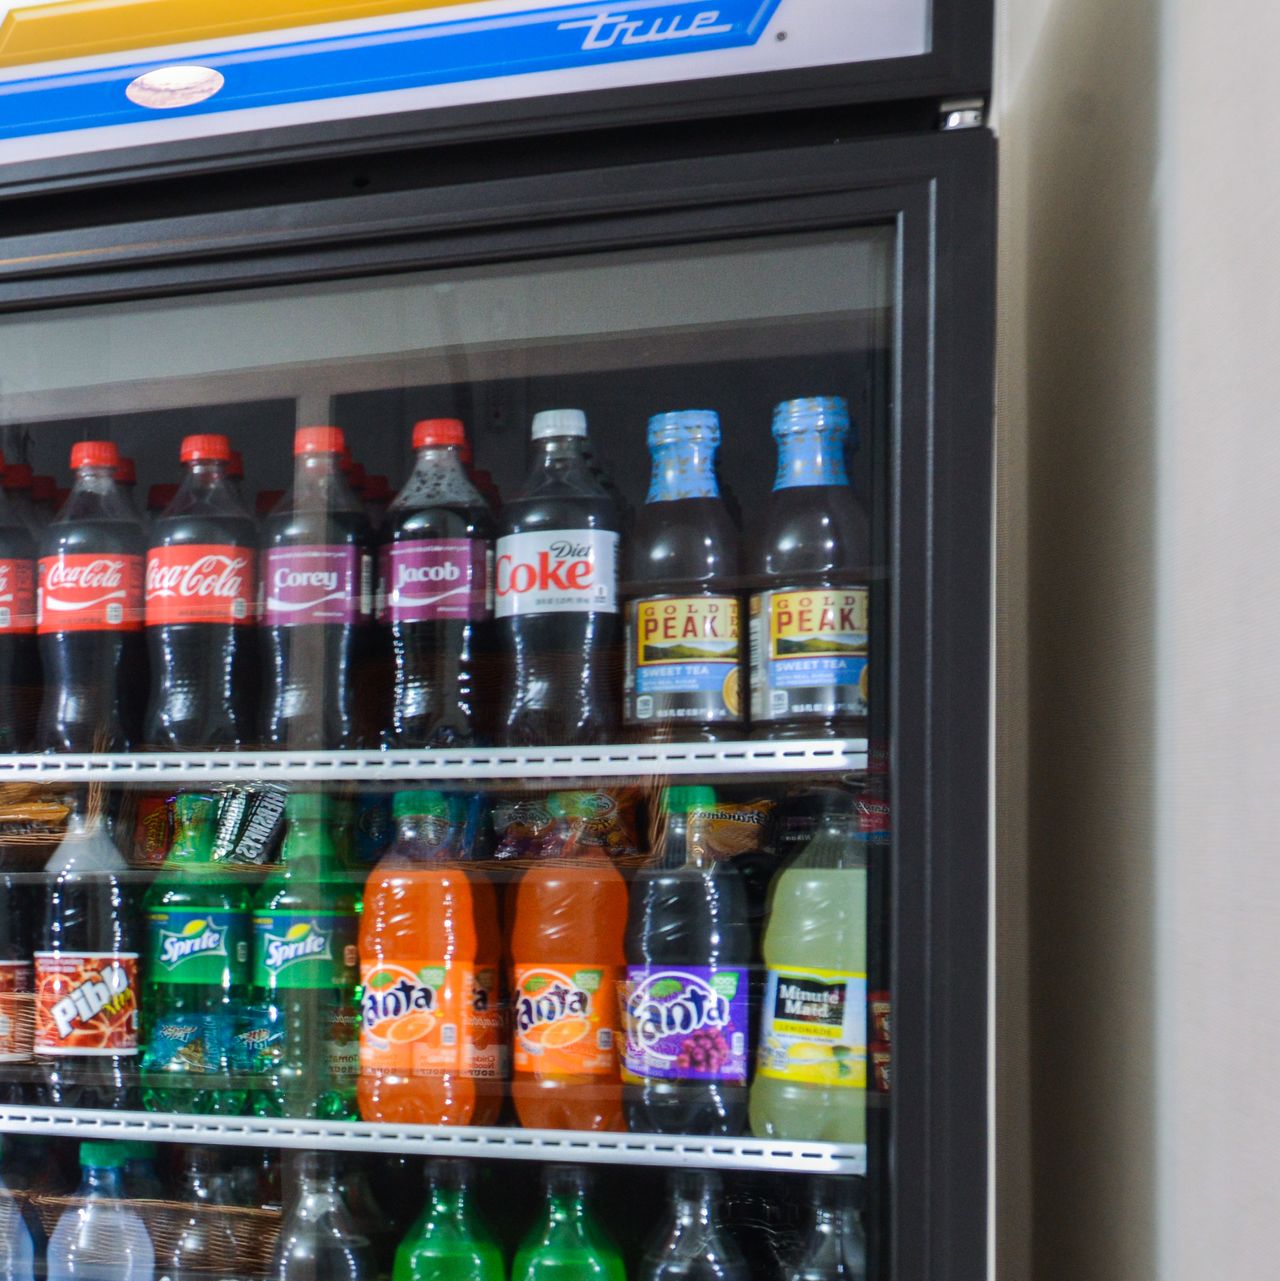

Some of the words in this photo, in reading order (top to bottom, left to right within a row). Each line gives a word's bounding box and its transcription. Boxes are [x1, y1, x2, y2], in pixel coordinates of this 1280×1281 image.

[557, 10, 733, 50] true
[47, 560, 124, 591] Coca-Cola
[274, 568, 337, 591] Corey
[397, 562, 460, 587] Jacob
[496, 551, 595, 597] Coke
[645, 604, 719, 617] GOLD
[777, 597, 856, 609] GOLD
[645, 614, 718, 640] PEAK
[777, 607, 856, 634] PEAK
[686, 665, 710, 676] TEA
[823, 658, 848, 670] TEA
[160, 930, 220, 962] Sprite
[266, 935, 325, 967] Sprite
[51, 965, 130, 1038] Pibb
[779, 983, 839, 1004] Minute
[785, 1000, 829, 1018] Maid
